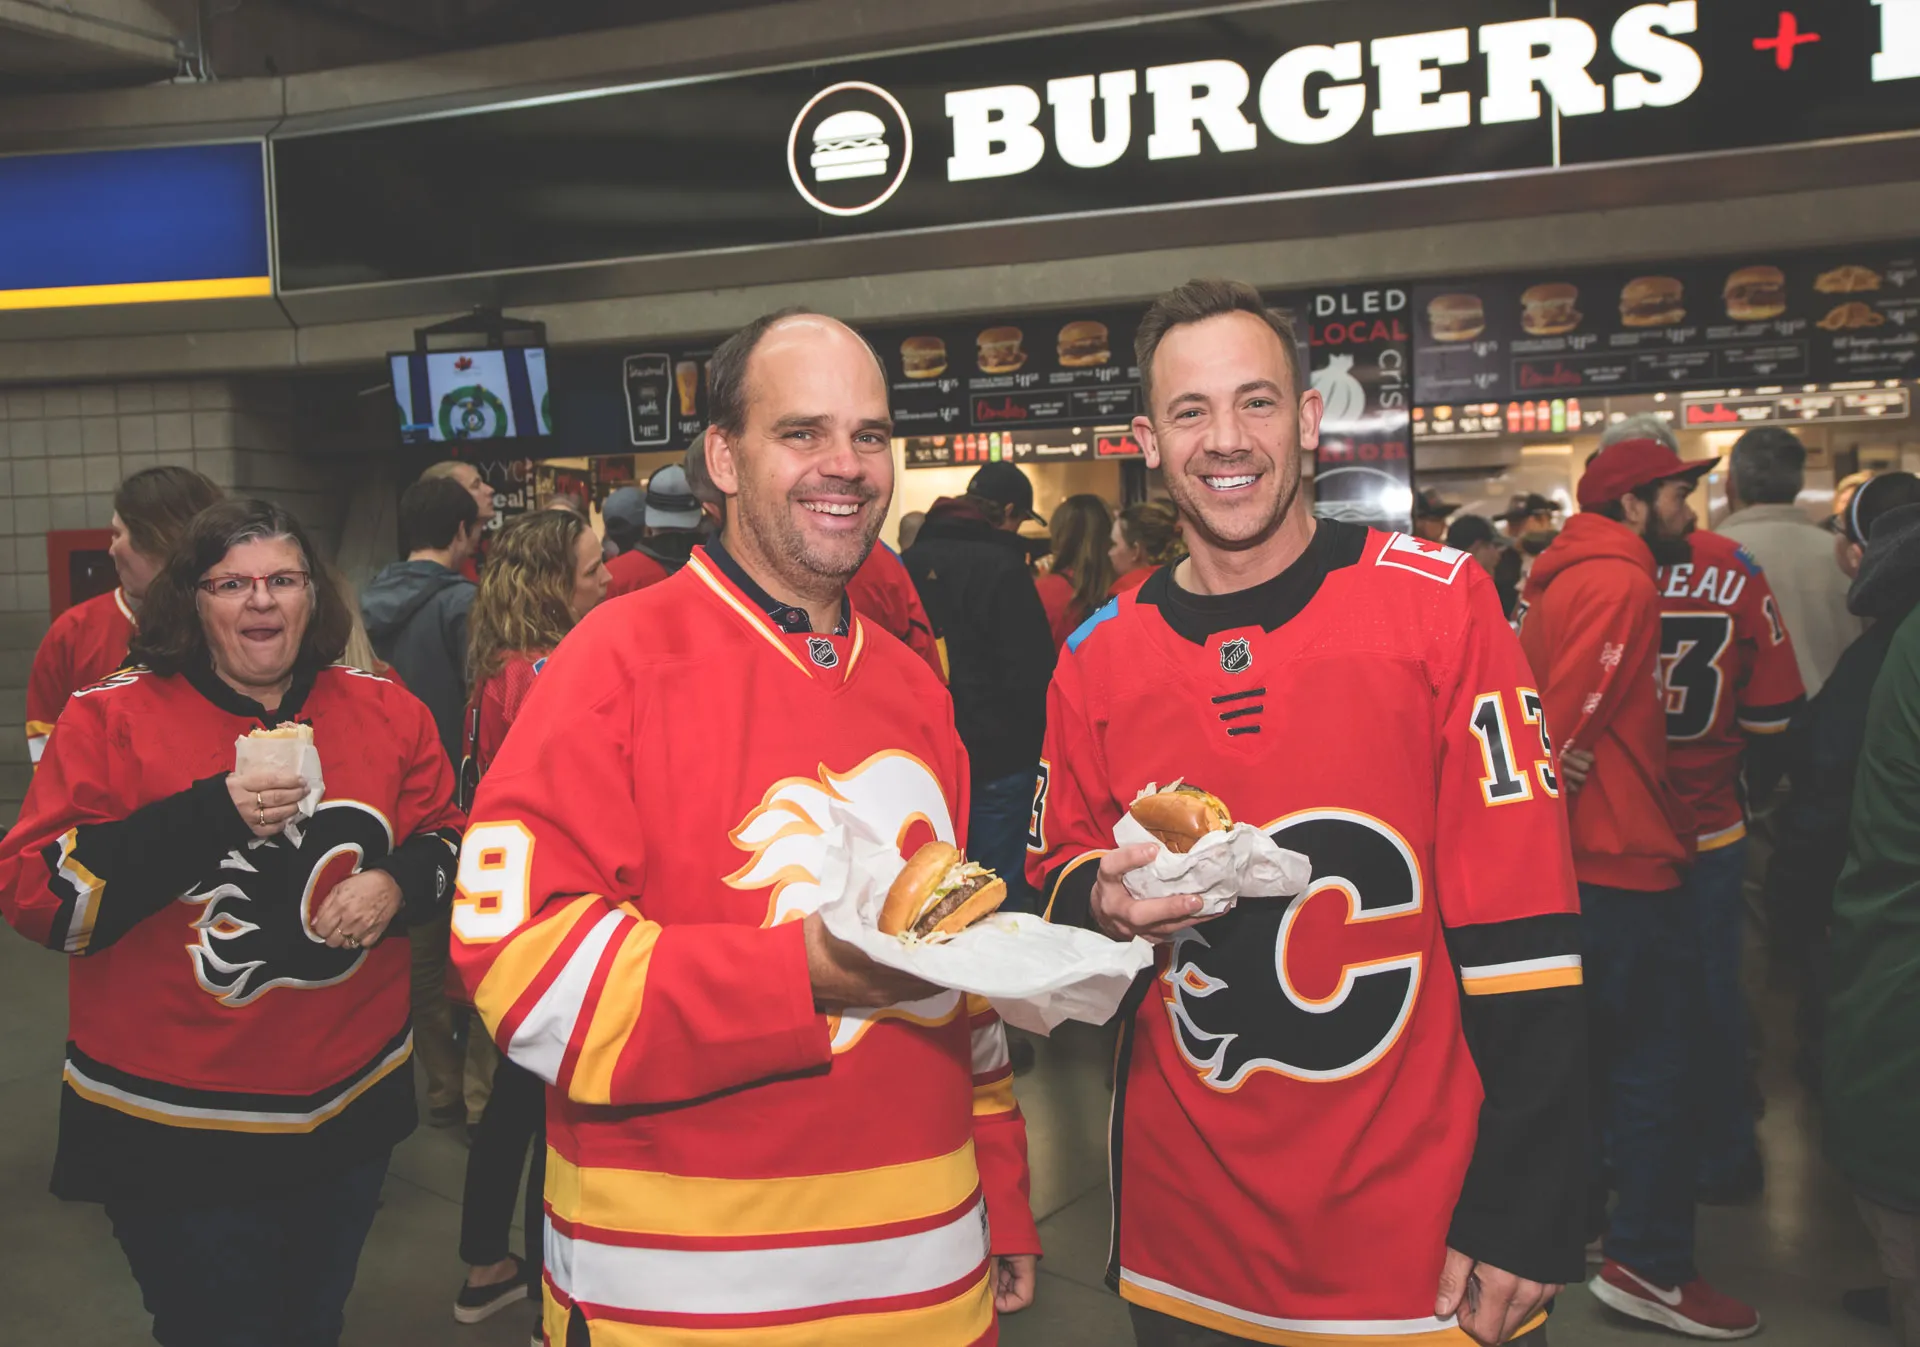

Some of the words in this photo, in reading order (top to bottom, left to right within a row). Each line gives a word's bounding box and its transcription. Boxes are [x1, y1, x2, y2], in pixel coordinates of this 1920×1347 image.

[946, 0, 1703, 182] BURGERS
[1307, 288, 1408, 317] DLED
[1309, 318, 1409, 347] LOCAL
[492, 488, 524, 508] eal
[1656, 563, 1747, 606] EAU
[815, 646, 832, 661] NHL
[1226, 647, 1245, 667] NHL
[450, 819, 537, 945] 9
